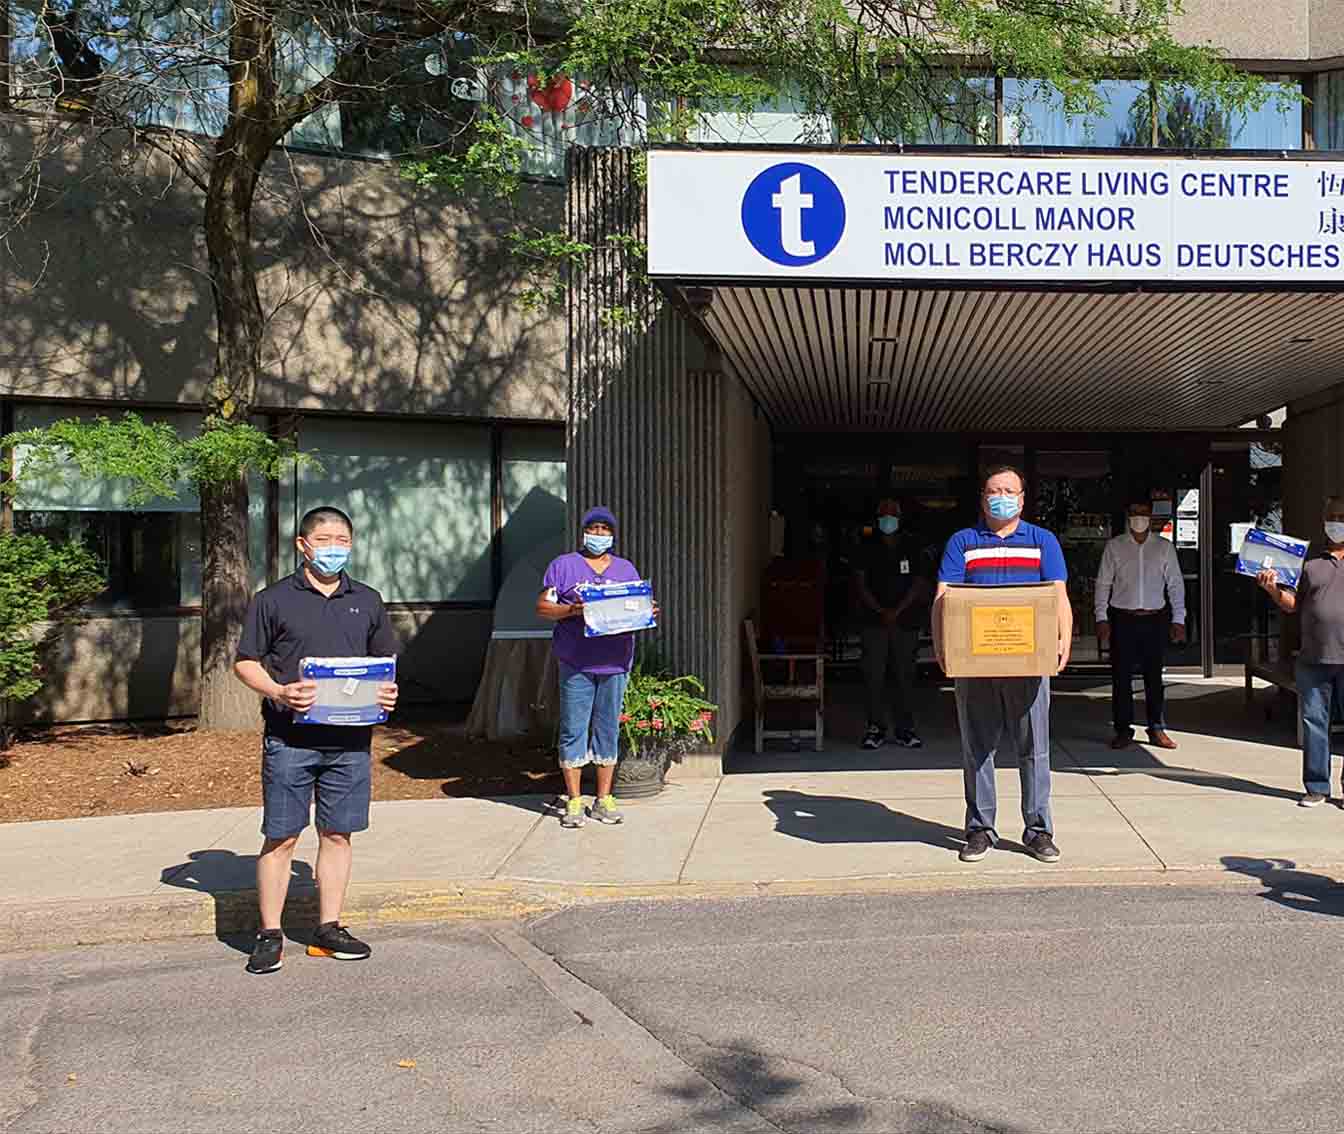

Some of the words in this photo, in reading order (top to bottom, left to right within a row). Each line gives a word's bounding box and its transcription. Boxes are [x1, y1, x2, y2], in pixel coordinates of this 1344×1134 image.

[884, 170, 1074, 196] TENDERCARE
[1080, 171, 1169, 196] LIVING
[1181, 173, 1289, 198] CENTRE
[883, 206, 1027, 232] MCNICOLL
[1035, 206, 1136, 231] MANOR
[883, 242, 964, 267] MOLL
[969, 242, 1076, 267] BERCZY
[1086, 242, 1163, 267] HAUS
[1177, 243, 1340, 268] DEUTSCHES
